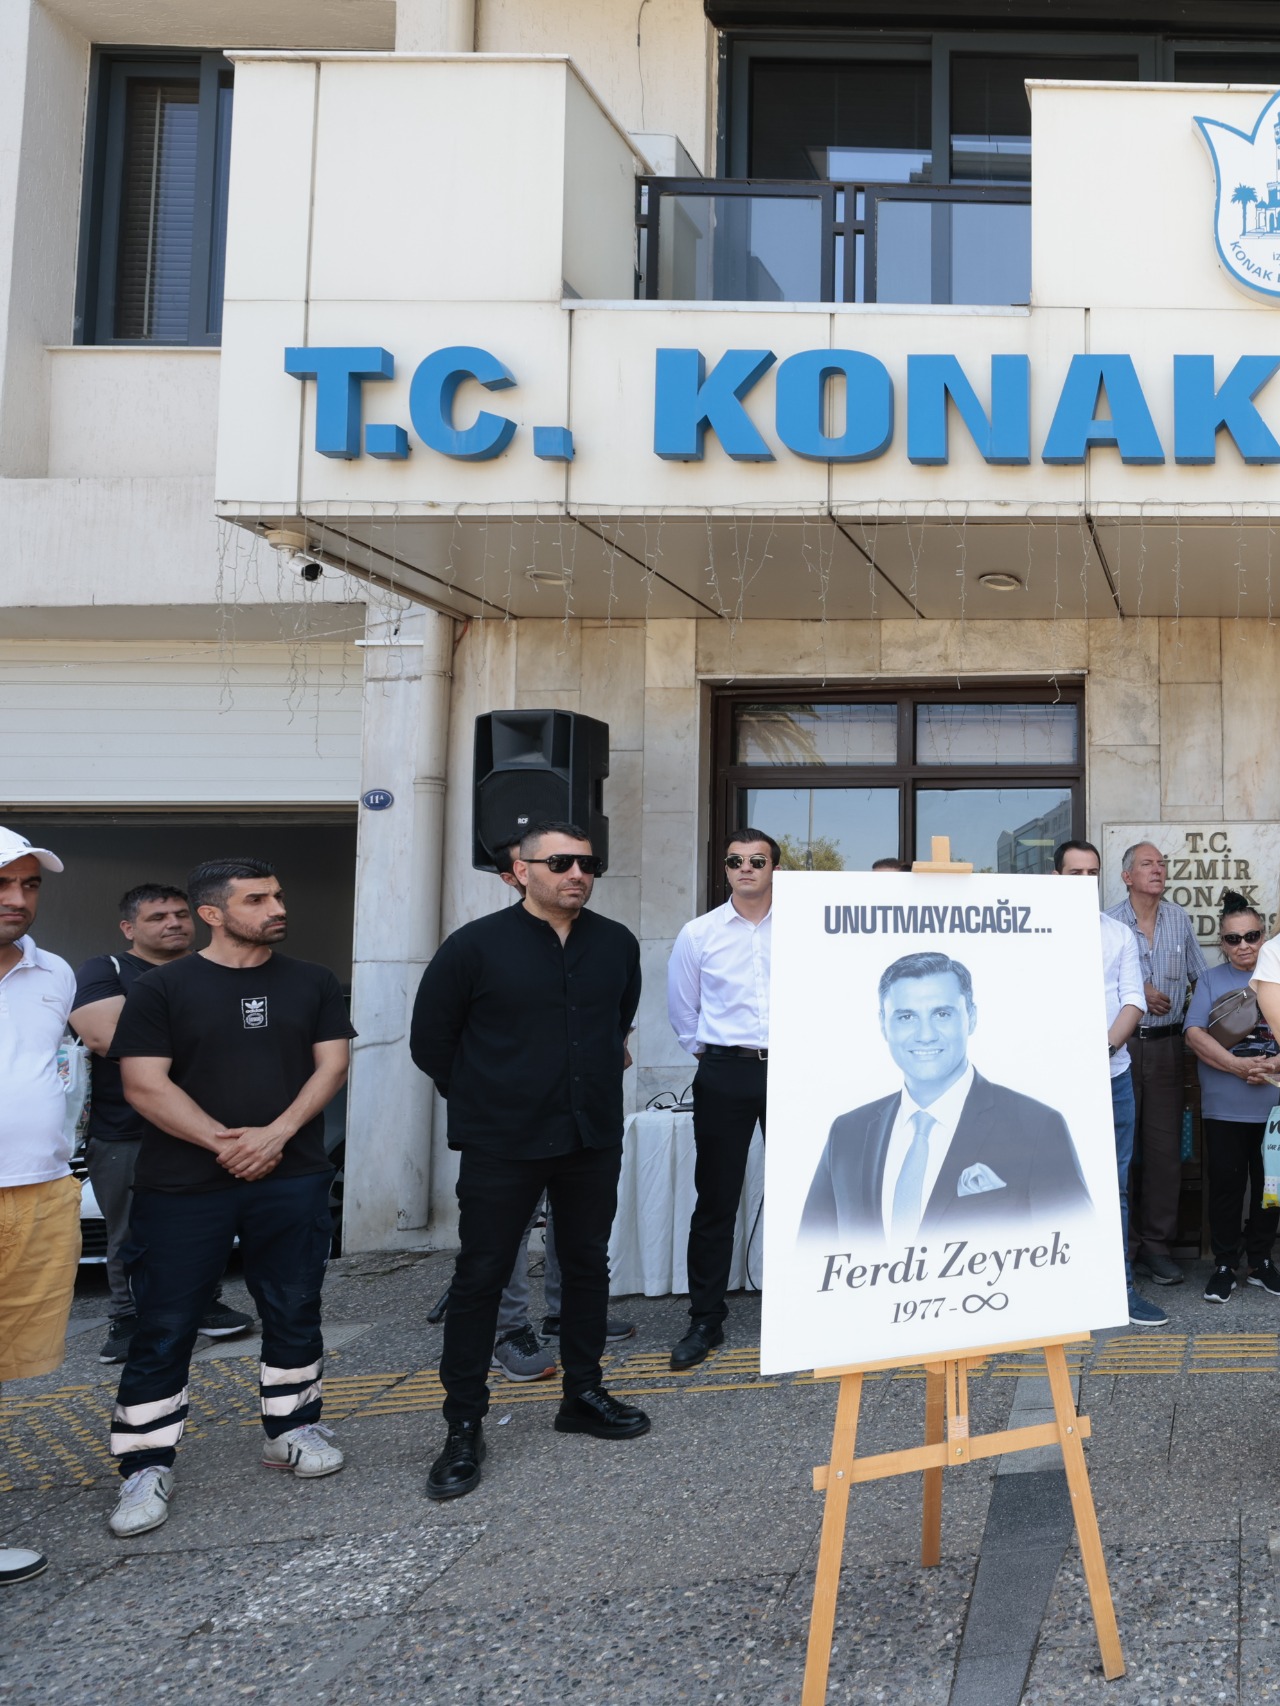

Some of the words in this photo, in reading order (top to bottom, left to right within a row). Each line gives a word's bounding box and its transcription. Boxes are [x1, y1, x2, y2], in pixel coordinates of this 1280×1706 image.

[1230, 241, 1273, 281] KONAK
[284, 345, 575, 462] T.C.
[1185, 831, 1232, 853] T.C.
[1164, 854, 1252, 881] İZMİR
[824, 898, 1053, 935] UNUTMAYACAĞIZ...
[816, 1246, 929, 1293] Ferdi
[936, 1231, 1071, 1287] Zeyrek
